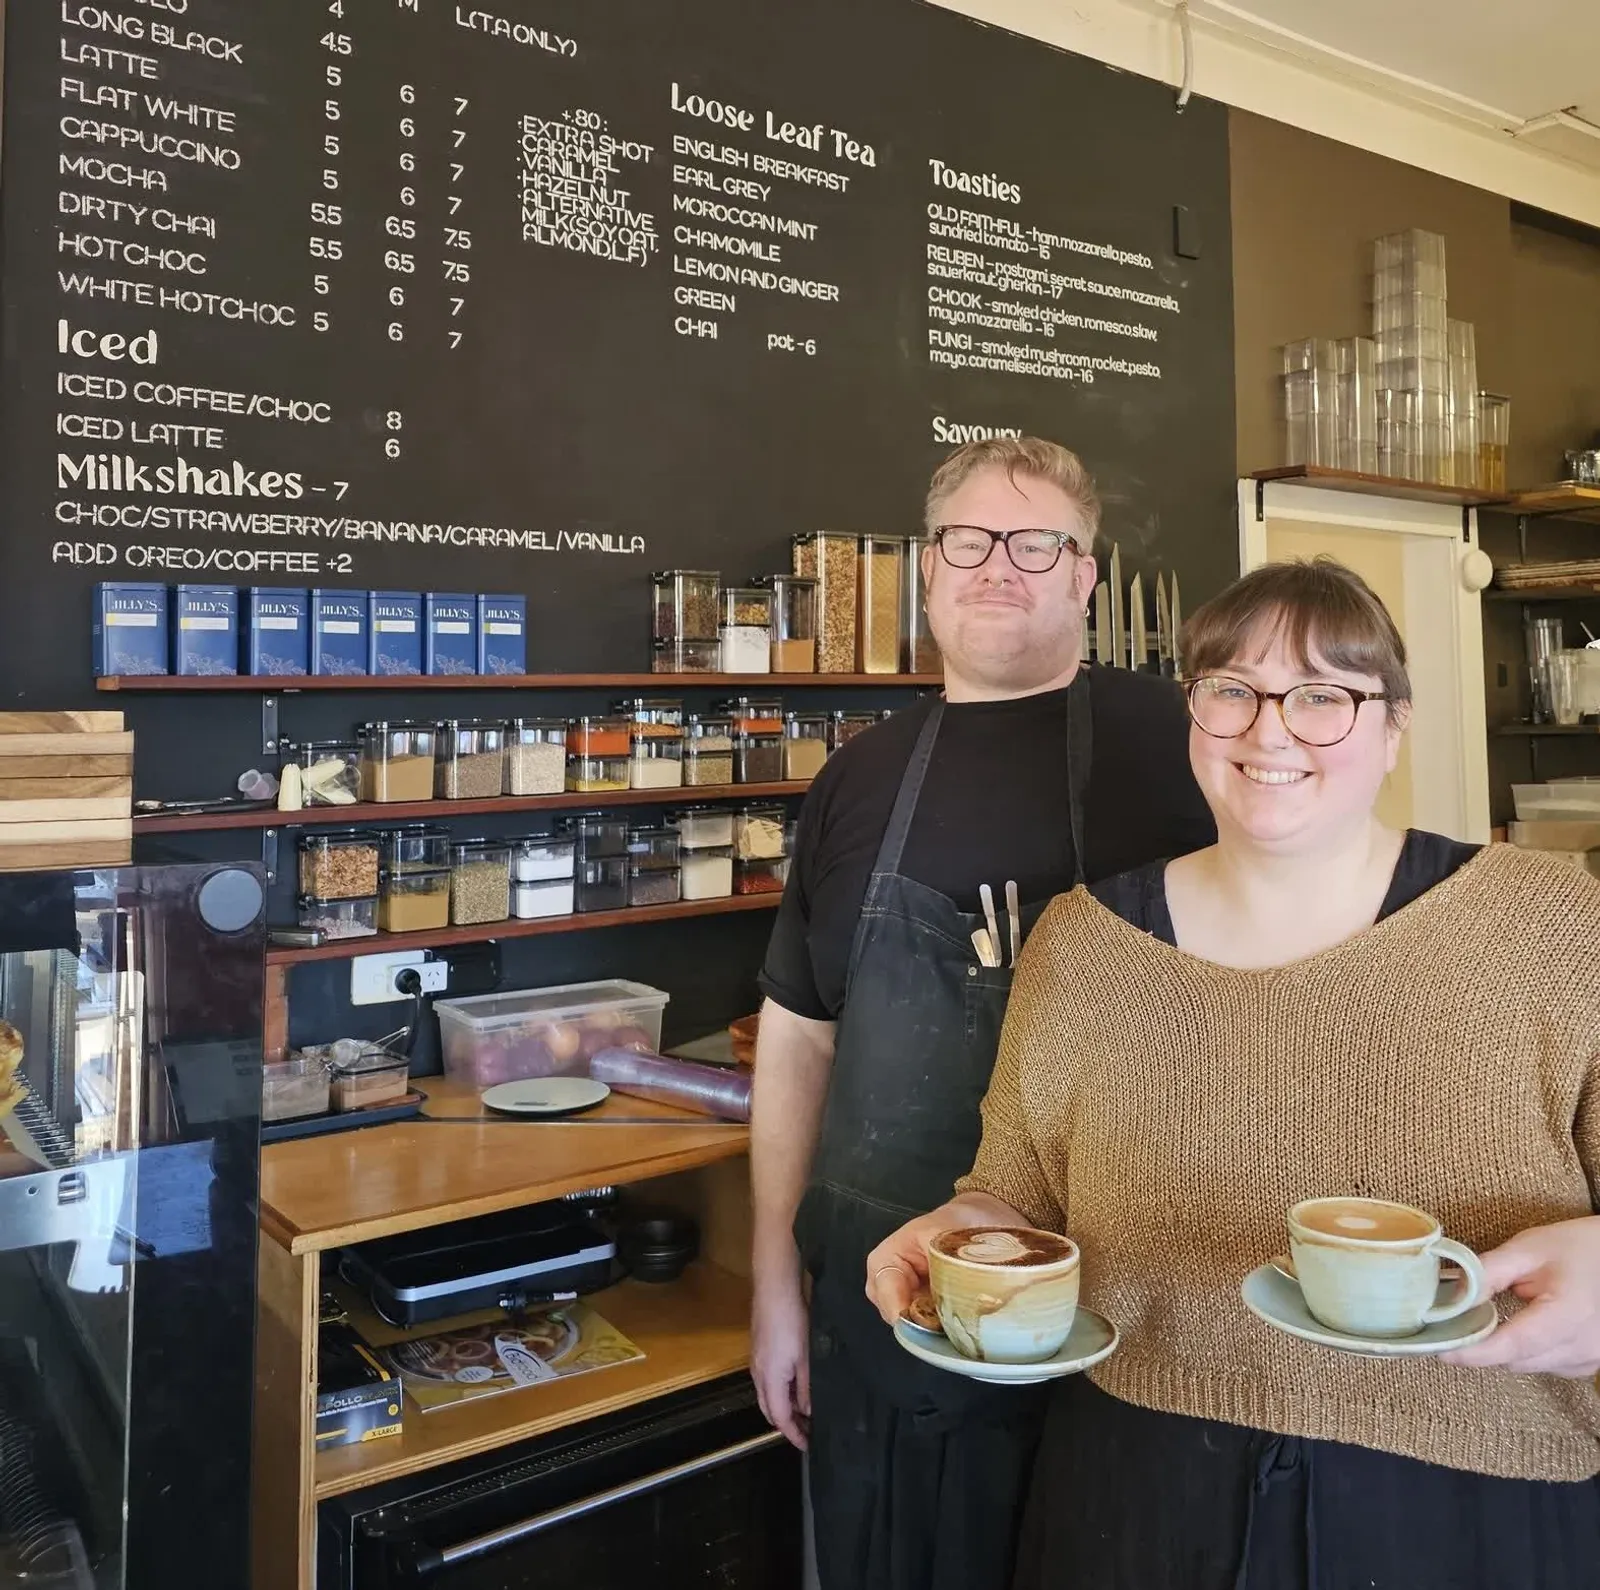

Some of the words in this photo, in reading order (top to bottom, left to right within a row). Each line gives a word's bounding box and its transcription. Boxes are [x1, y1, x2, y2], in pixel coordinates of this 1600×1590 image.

[328, 0, 344, 19] 4
[62, 0, 144, 39] LONG
[151, 22, 243, 64] BLACK
[327, 65, 342, 86] 5
[400, 84, 415, 104] 6
[454, 97, 468, 115] 7
[61, 38, 159, 80] LATTE
[325, 100, 340, 120] 5
[400, 117, 415, 137] 6
[452, 130, 466, 147] 7
[61, 78, 137, 110] FLAT
[144, 94, 236, 132] WHITE
[324, 135, 339, 155] 5
[400, 153, 415, 172] 6
[450, 163, 464, 181] 7
[671, 82, 754, 131] Loose
[765, 111, 824, 151] Leaf
[830, 129, 876, 167] Tea
[60, 116, 241, 170] CAPPUCCINO
[323, 170, 338, 189] 5
[400, 186, 416, 206] 6
[447, 196, 462, 215] 7
[522, 134, 620, 173] CARAMEL
[599, 135, 654, 163] SHOT
[673, 135, 748, 169] ENGLISH
[753, 154, 849, 193] BREAKFAST
[523, 151, 606, 186] VANILLA
[673, 164, 721, 191] EARL
[723, 177, 771, 202] GREY
[929, 159, 1021, 204] Toasties
[59, 154, 167, 192] MOCHA
[444, 227, 471, 249] 7.5
[523, 169, 630, 208] HAZELNUT
[523, 189, 654, 231] ALTERNATIVE
[673, 194, 776, 232] MOROCCAN
[777, 218, 818, 241] MINT
[927, 203, 958, 222] OLD
[960, 210, 1025, 239] FAITHFUL
[59, 191, 148, 225] DIRTY
[151, 208, 216, 239] CHAI
[309, 236, 343, 260] 5.5
[442, 260, 470, 282] 7.5
[674, 225, 781, 262] CHAMOMILE
[929, 222, 982, 244] sundried
[984, 230, 1029, 253] tomato
[927, 244, 984, 270] REUBEN
[314, 275, 329, 295] 5
[389, 286, 404, 306] 6
[450, 298, 464, 316] 7
[674, 254, 741, 283] LEMON
[741, 269, 778, 290] AND
[778, 276, 839, 301] GINGER
[58, 271, 154, 305] WHITE
[313, 312, 329, 332] 5
[388, 322, 403, 341] 6
[448, 331, 462, 349] 7
[674, 285, 735, 313] GREEN
[928, 286, 982, 309] CHOOK
[58, 319, 158, 365] Iced
[675, 316, 717, 339] CHAI
[768, 334, 795, 351] pot
[929, 329, 972, 351] FUNGI
[1041, 363, 1073, 379] onion
[58, 372, 127, 400] ICED
[133, 381, 331, 423] COFFEE/CHOC
[385, 411, 402, 430] 8
[57, 413, 124, 440] ICED
[131, 421, 224, 449] LATTE
[384, 438, 401, 458] 6
[58, 453, 303, 499] Milkshakes
[333, 481, 348, 501] 7
[52, 541, 117, 566] ADD
[126, 546, 319, 575] OREO/COFFEE
[326, 554, 353, 574] +2
[112, 600, 158, 610] JILLY'S
[186, 601, 230, 612] JILLY'S
[258, 604, 300, 614] JILLY'S
[320, 605, 360, 616] JILLY'S
[376, 606, 414, 617] JILLY'S
[434, 608, 470, 618] JILLY'S
[485, 609, 520, 620] JILLY'S
